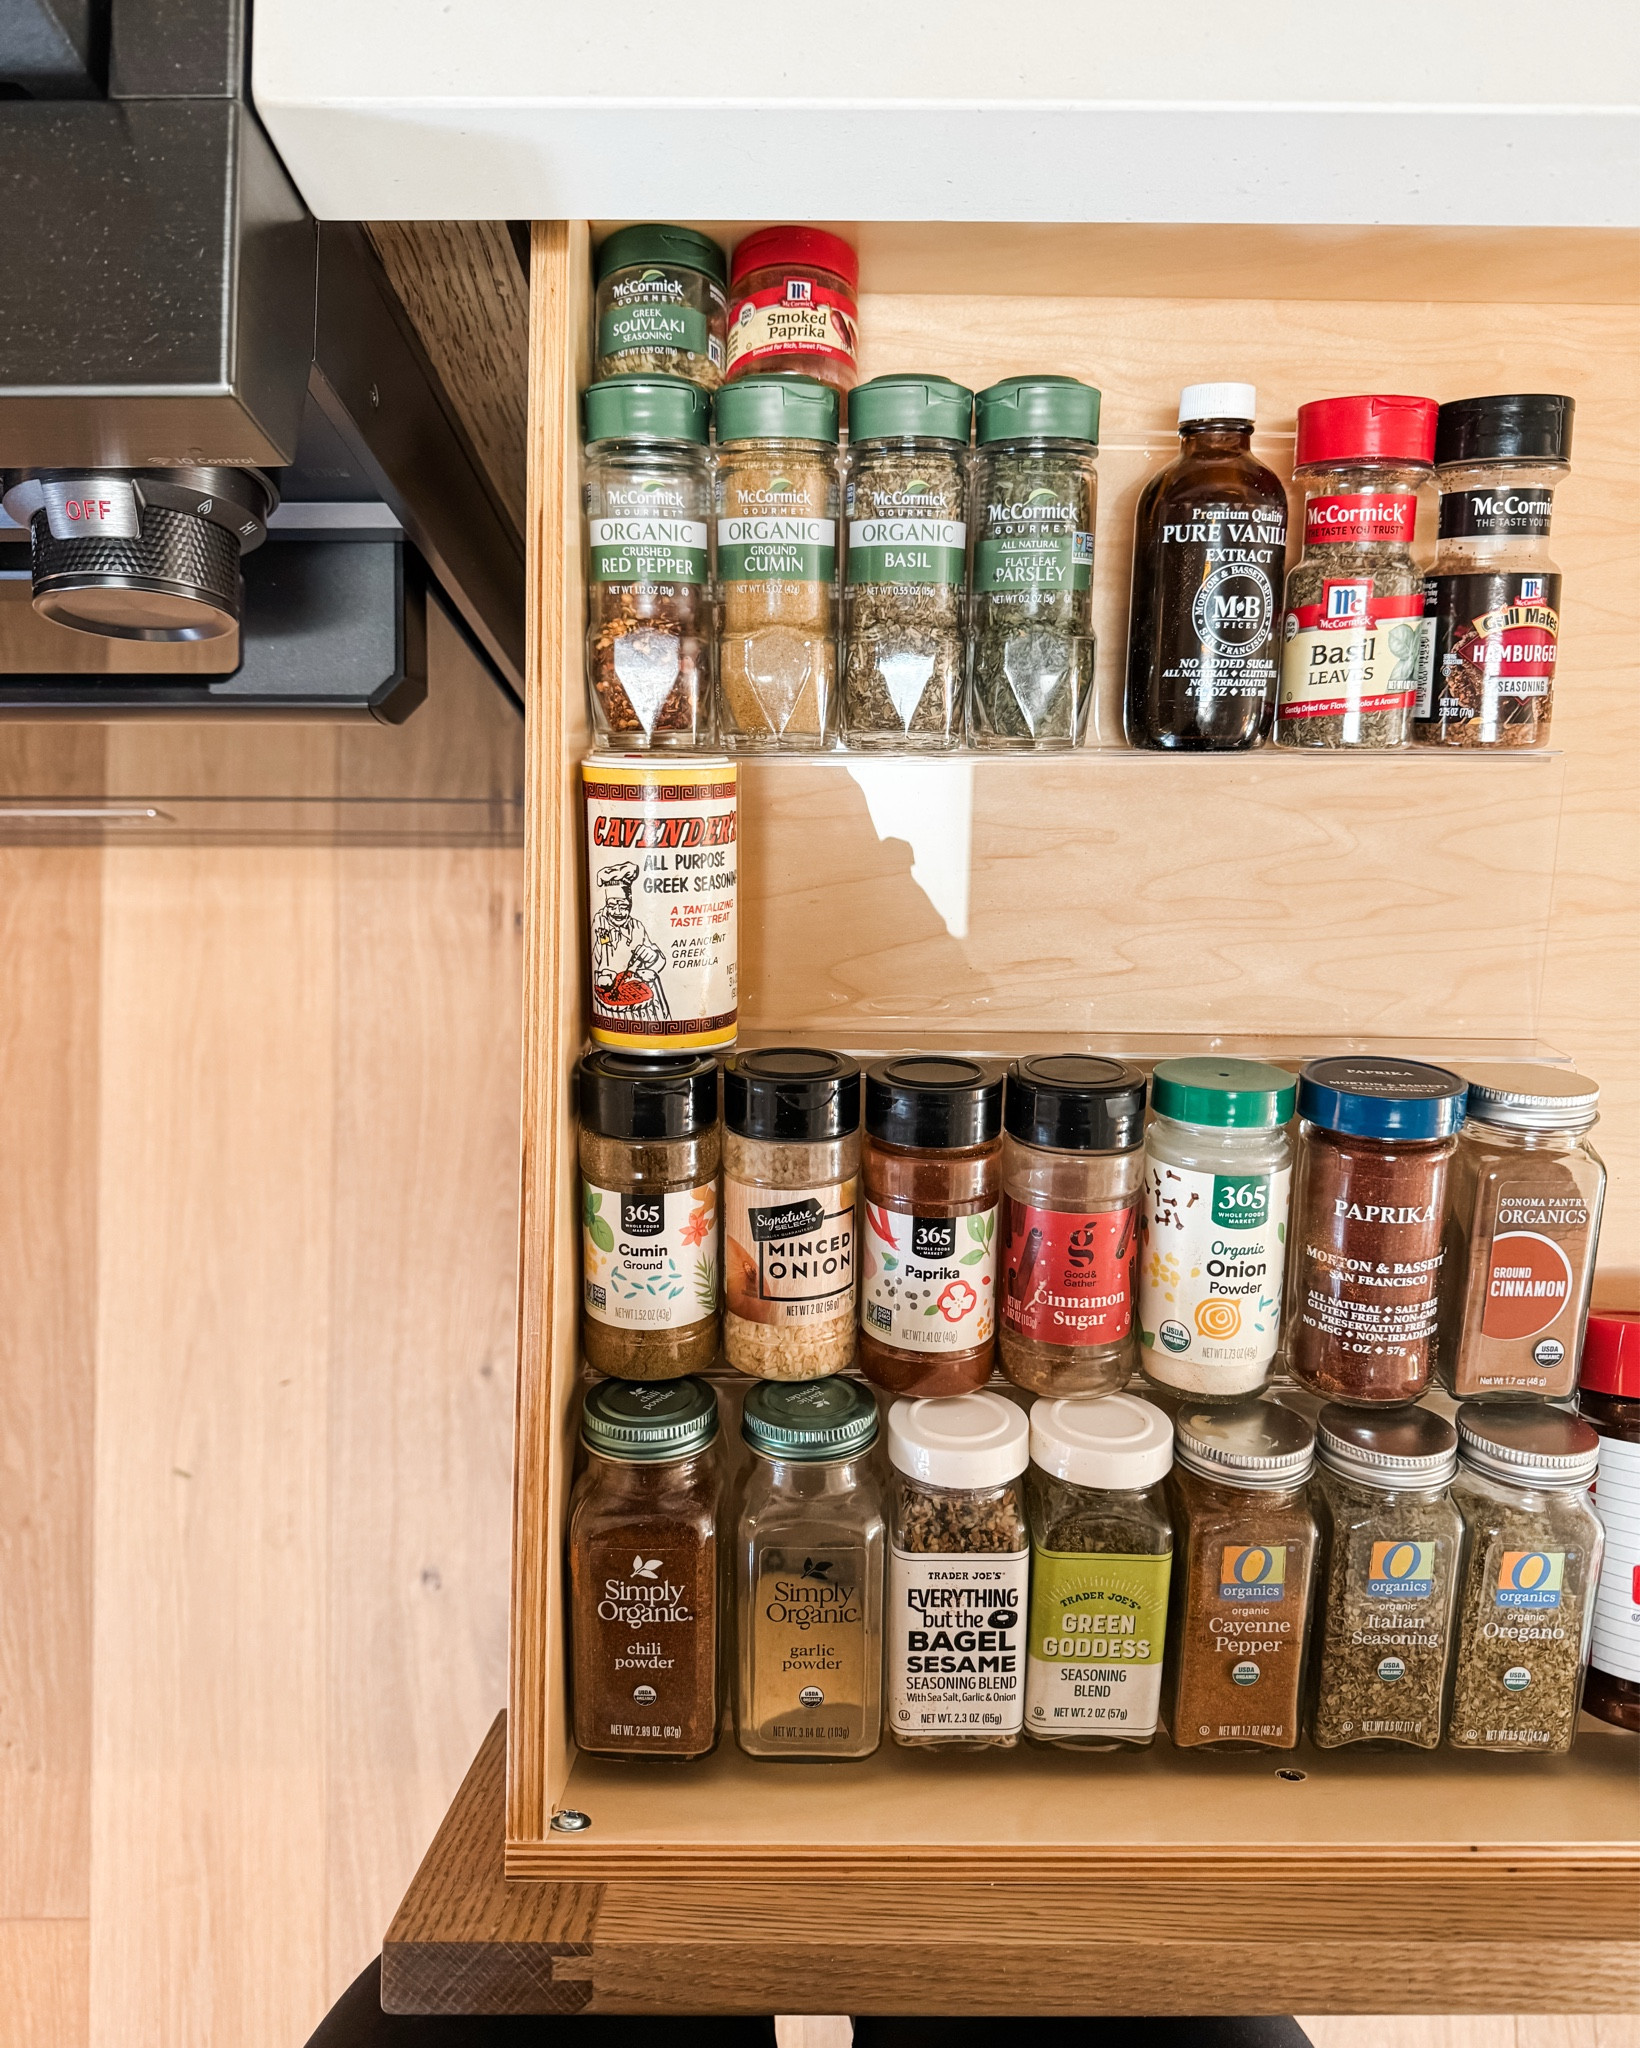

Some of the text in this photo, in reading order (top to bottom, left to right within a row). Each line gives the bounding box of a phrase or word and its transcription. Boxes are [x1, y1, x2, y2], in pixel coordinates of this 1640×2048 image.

[612, 280, 684, 299] McCormick
[633, 308, 662, 318] GREEK
[767, 311, 827, 326] Smoked
[613, 318, 685, 336] SOUVLAKI
[769, 325, 825, 340] Paprika
[623, 331, 672, 343] SEASONING
[608, 491, 684, 508] McCormick
[737, 490, 812, 505] McCormick
[873, 492, 948, 508] McCormick
[66, 500, 111, 520] OFF
[988, 503, 1079, 522] McCormick
[1193, 509, 1282, 524] Premium Quality
[1308, 504, 1403, 524] McCormick
[240, 521, 258, 536] HI
[1476, 518, 1543, 527] THE TASTE YOU
[600, 523, 693, 543] ORGANIC
[729, 522, 820, 541] ORGANIC
[862, 523, 954, 543] ORGANIC
[1162, 524, 1221, 543] PURE
[1309, 526, 1400, 536] THE TASTE YOU TRUST
[622, 546, 671, 557] CRUSHED
[750, 546, 797, 555] GROUND
[1001, 540, 1059, 549] ALL NATURAL
[885, 553, 931, 568] BASIL
[1006, 557, 1057, 567] FLAT LEAF
[1206, 549, 1273, 563] EXTRACT
[602, 558, 693, 575] RED PEPPER
[744, 557, 803, 572] CUMIN
[996, 567, 1066, 582] PARSLEY
[1525, 609, 1556, 631] Mates
[1310, 638, 1375, 666] Basil
[1498, 680, 1544, 692] SEASONING
[644, 851, 725, 871] ALL PURPOSE
[644, 878, 688, 893] GREEK
[671, 899, 733, 915] A TANTALIZING
[670, 912, 730, 927] TASTE TREAT
[671, 934, 726, 947] AN ANCIENT
[672, 948, 705, 958] GREEK
[673, 959, 718, 968] FORMULA
[1219, 1184, 1266, 1209] 365
[1501, 1198, 1589, 1207] SONOMA PANTRY
[625, 1204, 660, 1222] 365
[1334, 1199, 1435, 1224] PAPRIKA
[1499, 1210, 1587, 1223] ORGANICS
[757, 1211, 812, 1231] Signature
[775, 1218, 811, 1230] SELECT
[916, 1227, 951, 1245] 365
[619, 1244, 668, 1257] Cumin
[769, 1233, 850, 1257] MINCED
[1211, 1241, 1265, 1260] Organic
[624, 1260, 663, 1270] Ground
[769, 1251, 850, 1279] ONION
[1306, 1245, 1444, 1274] MORTON & BASSETT
[905, 1265, 959, 1282] Paprika
[1207, 1260, 1266, 1278] Onion
[1493, 1267, 1531, 1279] GROUND
[1064, 1279, 1096, 1287] Gather
[1330, 1270, 1427, 1287] SAN FRANCISCO
[1210, 1282, 1262, 1294] Powder
[1491, 1281, 1566, 1298] CINNAMON
[1036, 1290, 1125, 1309] Cinnamon
[1309, 1290, 1438, 1314] ALL NATURAL SALT FREE
[1308, 1299, 1437, 1324] GLUTEN FREE NON-GMO
[1054, 1311, 1106, 1330] Sugar
[1322, 1313, 1426, 1333] PRESERVATIVE FREE
[1303, 1315, 1438, 1342] NO MSG NON-IRRADIATED
[928, 1572, 1001, 1580] TRADER JOE'S
[605, 1579, 685, 1607] Simply
[775, 1582, 854, 1608] Simply
[1223, 1586, 1279, 1599] organics
[1371, 1582, 1427, 1594] organics
[908, 1588, 1018, 1612] EVERYTHING
[1060, 1592, 1139, 1609] TRADER JOE'S
[1500, 1592, 1556, 1604] organics
[1232, 1607, 1270, 1616] organic
[1379, 1602, 1417, 1611] organic
[766, 1603, 857, 1630] Organic
[923, 1610, 983, 1628] but the
[1062, 1613, 1135, 1635] GREEN
[1368, 1614, 1425, 1629] Italian
[1507, 1613, 1545, 1622] organic
[1209, 1618, 1291, 1636] Cayenne
[1483, 1623, 1565, 1642] Oregano
[908, 1631, 1016, 1652] BAGEL
[1215, 1637, 1283, 1655] Pepper
[1351, 1632, 1438, 1648] Seasoning
[627, 1643, 661, 1655] chili
[790, 1644, 835, 1658] garlic
[1043, 1637, 1151, 1659] GODDESS
[615, 1656, 674, 1670] powder
[782, 1658, 842, 1672] powder
[907, 1655, 1016, 1673] SESAME
[907, 1676, 1017, 1690] SEASONING BLEND
[1061, 1669, 1127, 1682] SEASONING
[907, 1693, 1016, 1702] With Sea Salt, Garlic & Onion
[1074, 1685, 1111, 1698] BLEND
[921, 1713, 1002, 1725] NET WT. 2.3 OZ (65g)
[1054, 1708, 1127, 1720] NET WT. 2 OZ (57g)
